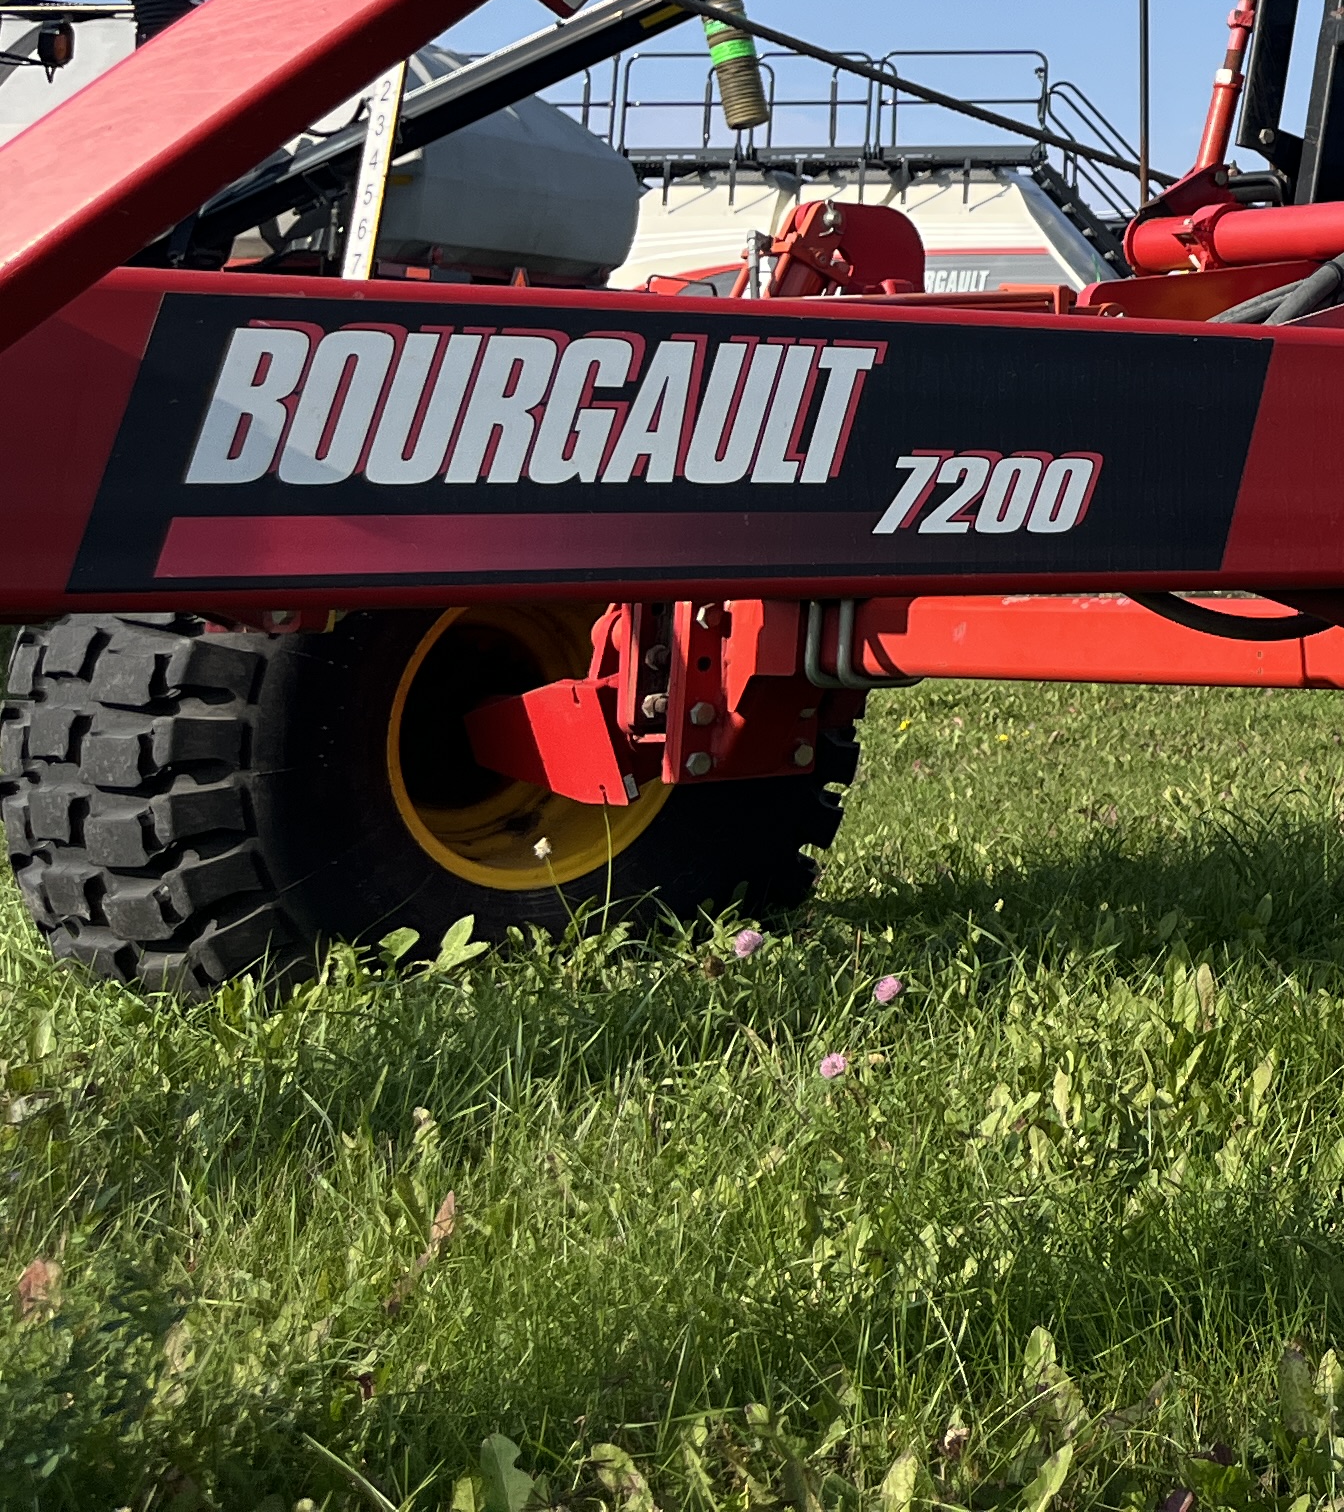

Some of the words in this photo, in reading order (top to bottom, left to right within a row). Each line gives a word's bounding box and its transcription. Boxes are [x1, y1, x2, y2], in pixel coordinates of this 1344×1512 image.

[379, 80, 392, 102] 2
[374, 114, 386, 136] 3
[368, 149, 379, 169] 4
[362, 183, 373, 205] 5
[356, 218, 367, 240] 6
[351, 253, 362, 275] 7
[924, 270, 991, 293] RGAULT
[184, 322, 882, 487] BOURGAULT
[872, 454, 1098, 536] 7200
